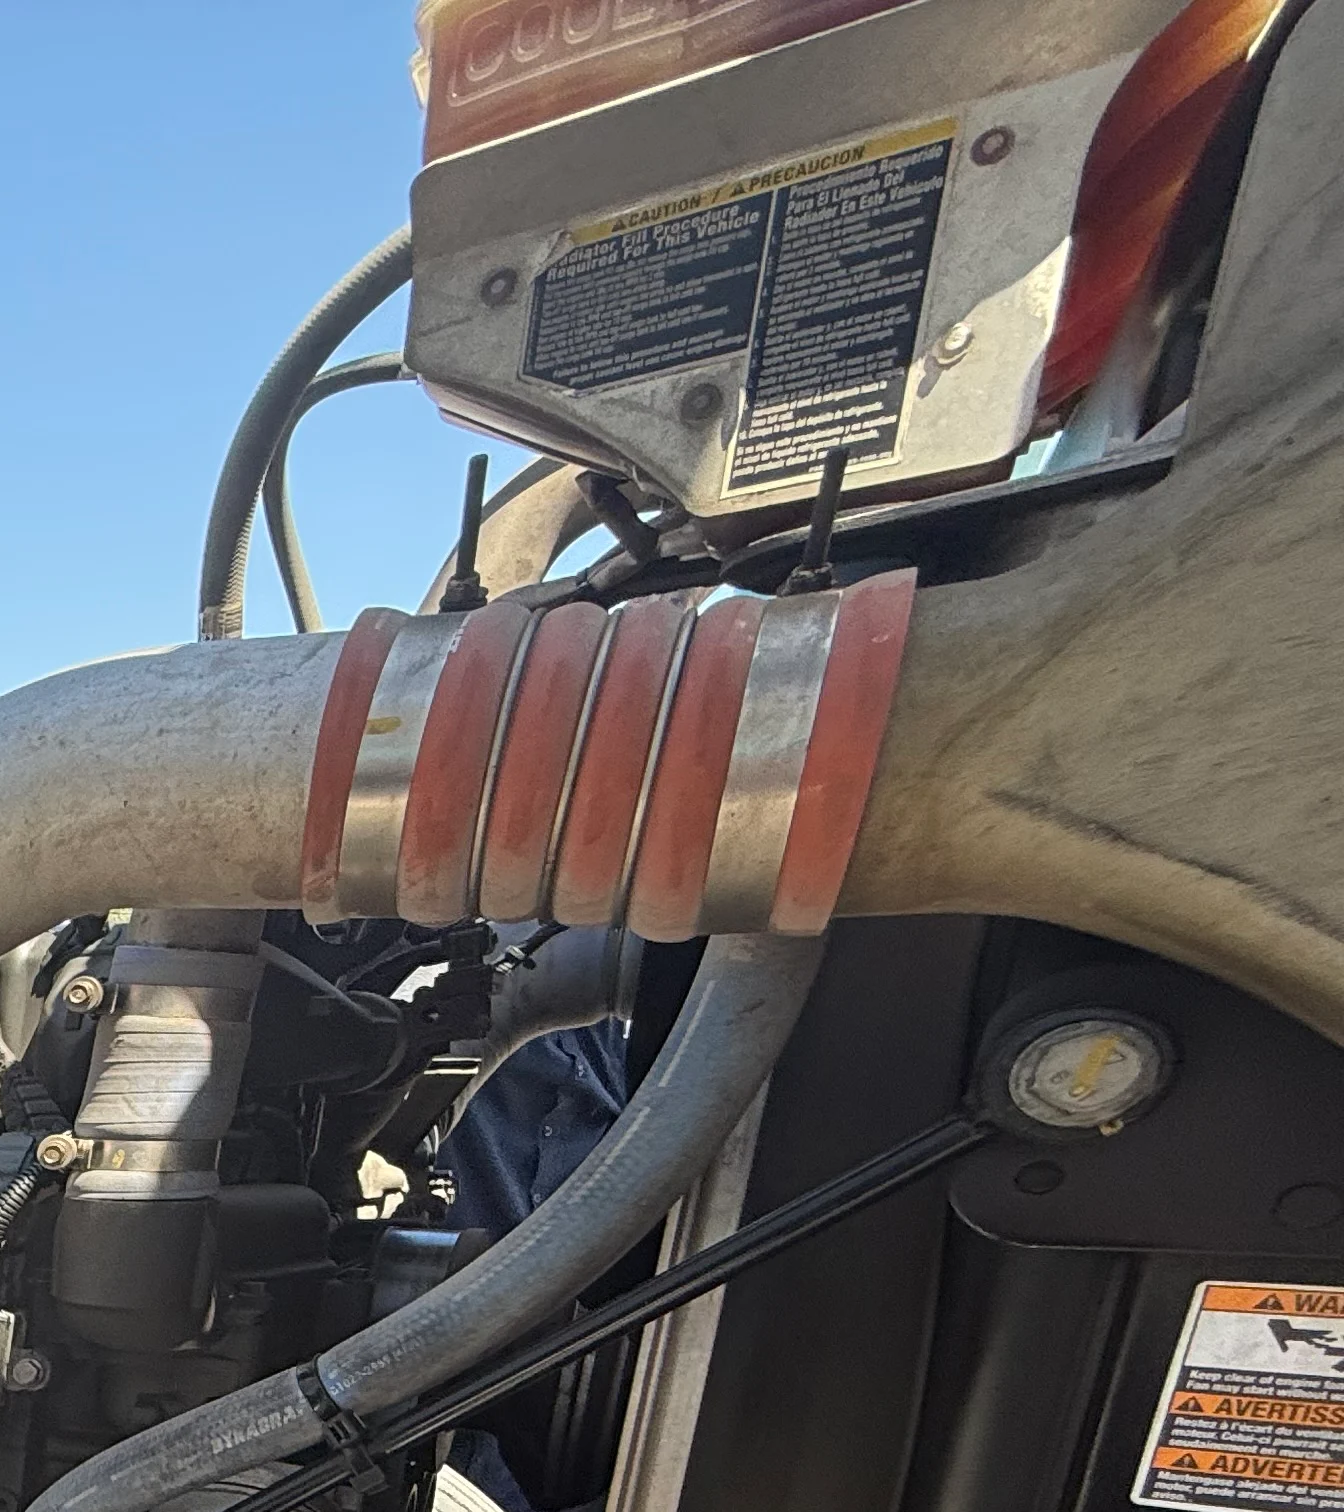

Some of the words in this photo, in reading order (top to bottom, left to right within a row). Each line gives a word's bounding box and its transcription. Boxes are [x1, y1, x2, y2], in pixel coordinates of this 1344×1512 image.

[628, 195, 701, 227] CAUTION
[748, 146, 866, 191] PRECAUCION
[546, 257, 620, 281] Required
[624, 243, 650, 259] For
[656, 232, 690, 251] This
[697, 211, 759, 239] Vehicle
[554, 241, 616, 267] adiator
[622, 232, 648, 247] Fill
[653, 204, 740, 239] Procedure
[1296, 1294, 1344, 1314] WA
[1209, 1455, 1344, 1483] ADVERTE
